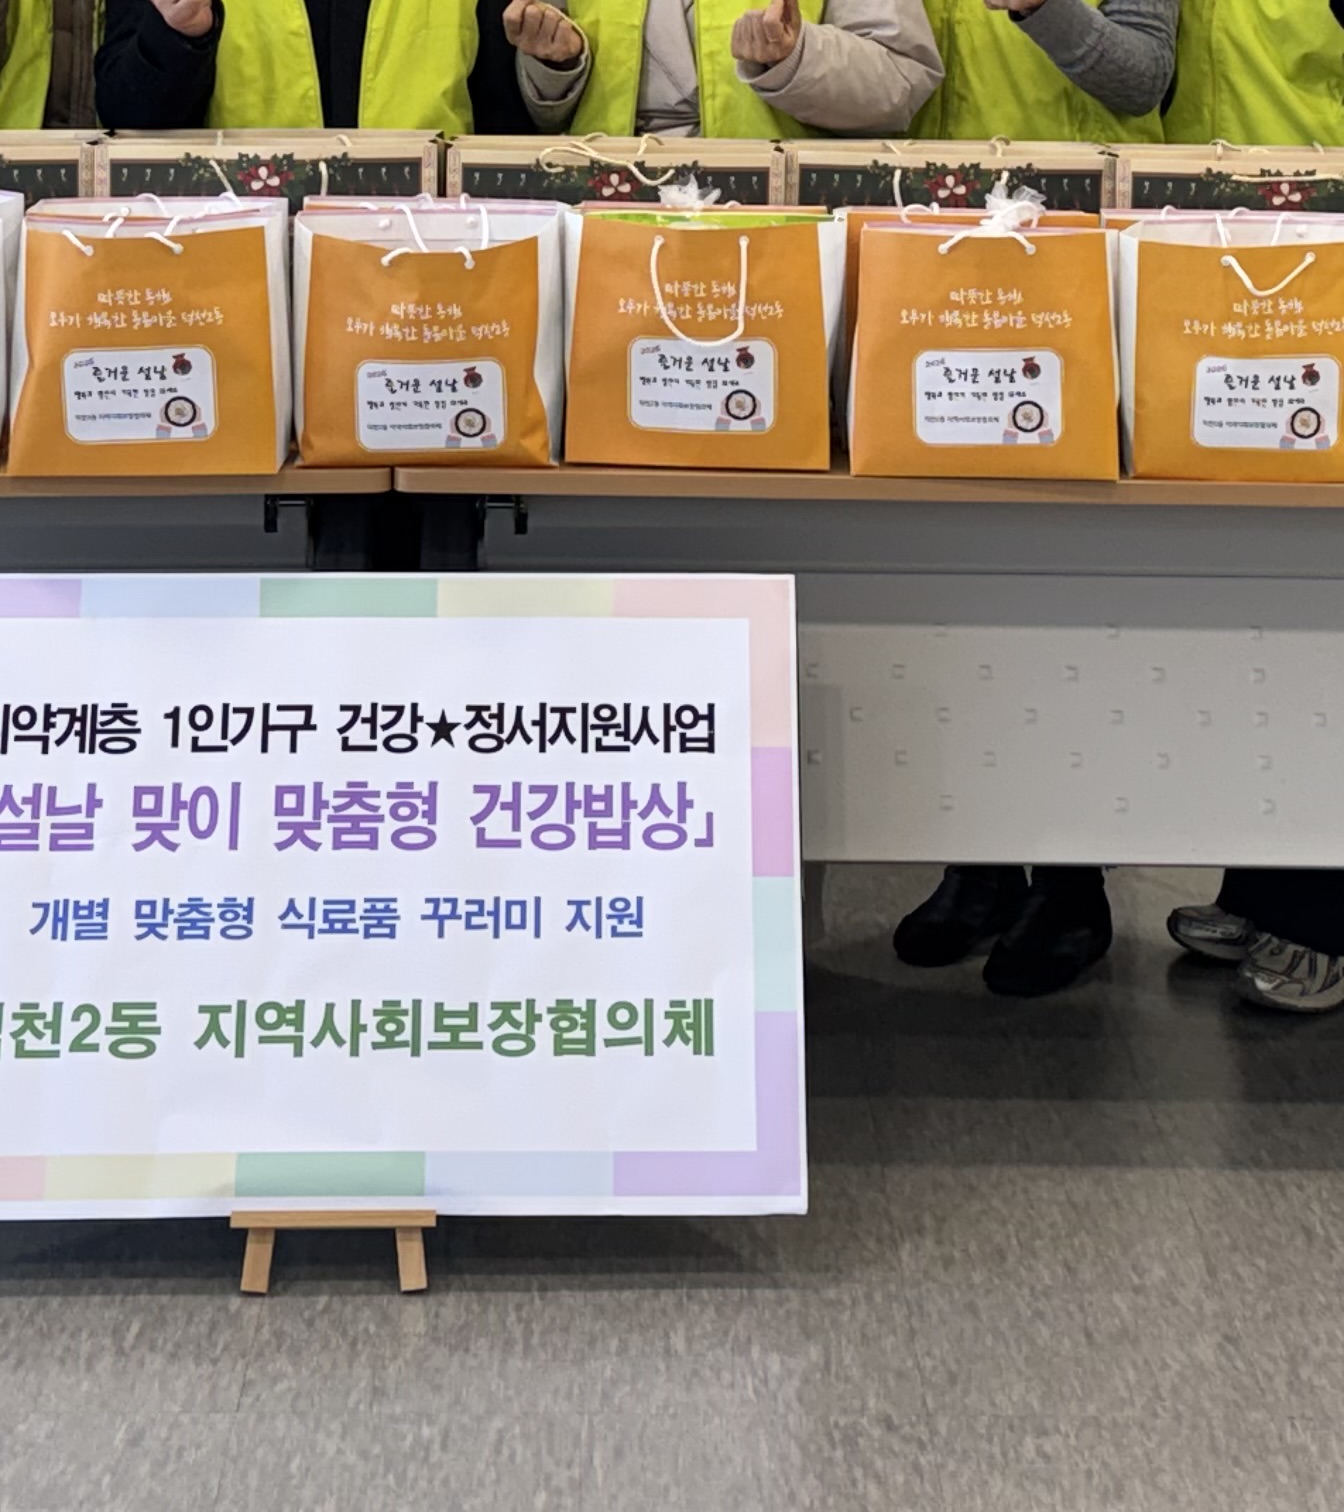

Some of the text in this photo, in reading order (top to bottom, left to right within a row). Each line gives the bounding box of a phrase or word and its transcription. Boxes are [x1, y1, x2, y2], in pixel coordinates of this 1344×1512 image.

[658, 354, 730, 372] 즐거운 설날
[92, 365, 167, 382] 즐거운 설날
[943, 367, 1016, 383] 즐거운 설날
[1224, 374, 1296, 390] 즐거운 설날
[385, 377, 458, 393] 즐거운 설날
[163, 703, 317, 754] 1인가구
[336, 702, 715, 754] 건강★정서지원사업
[132, 782, 241, 852] 맞이
[274, 781, 438, 851] 맞춤형
[470, 781, 713, 851] 건강밥상」
[29, 896, 643, 941] 개별 맞춤형 식료품 꾸러미 지원
[194, 998, 714, 1058] 지역사회보장협의체
